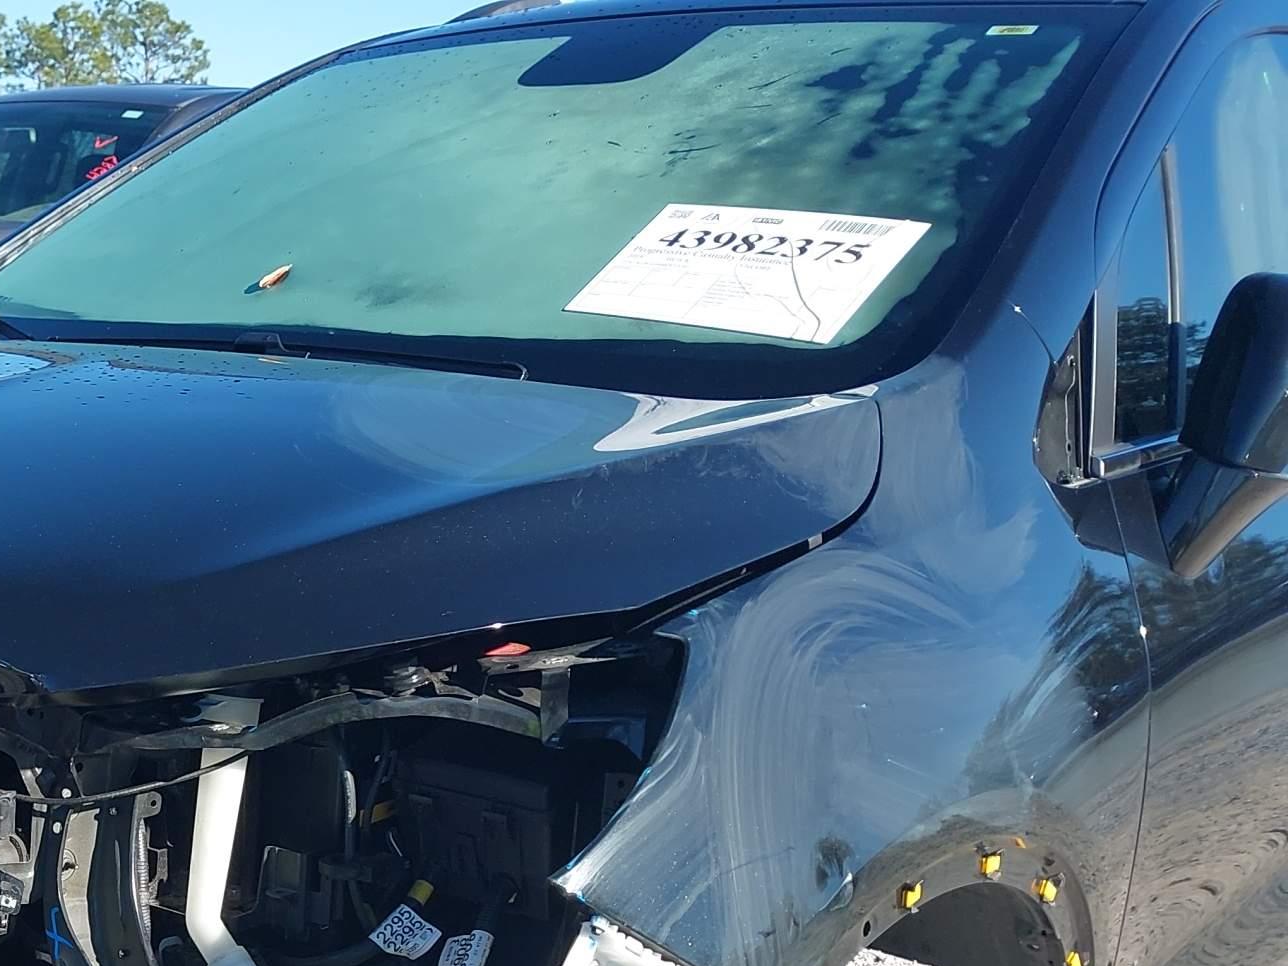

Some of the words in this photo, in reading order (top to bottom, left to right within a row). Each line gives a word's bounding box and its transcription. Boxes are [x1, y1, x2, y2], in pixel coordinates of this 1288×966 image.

[659, 228, 870, 264] 43982375
[376, 907, 412, 945] 2295
[387, 917, 423, 953] 2295
